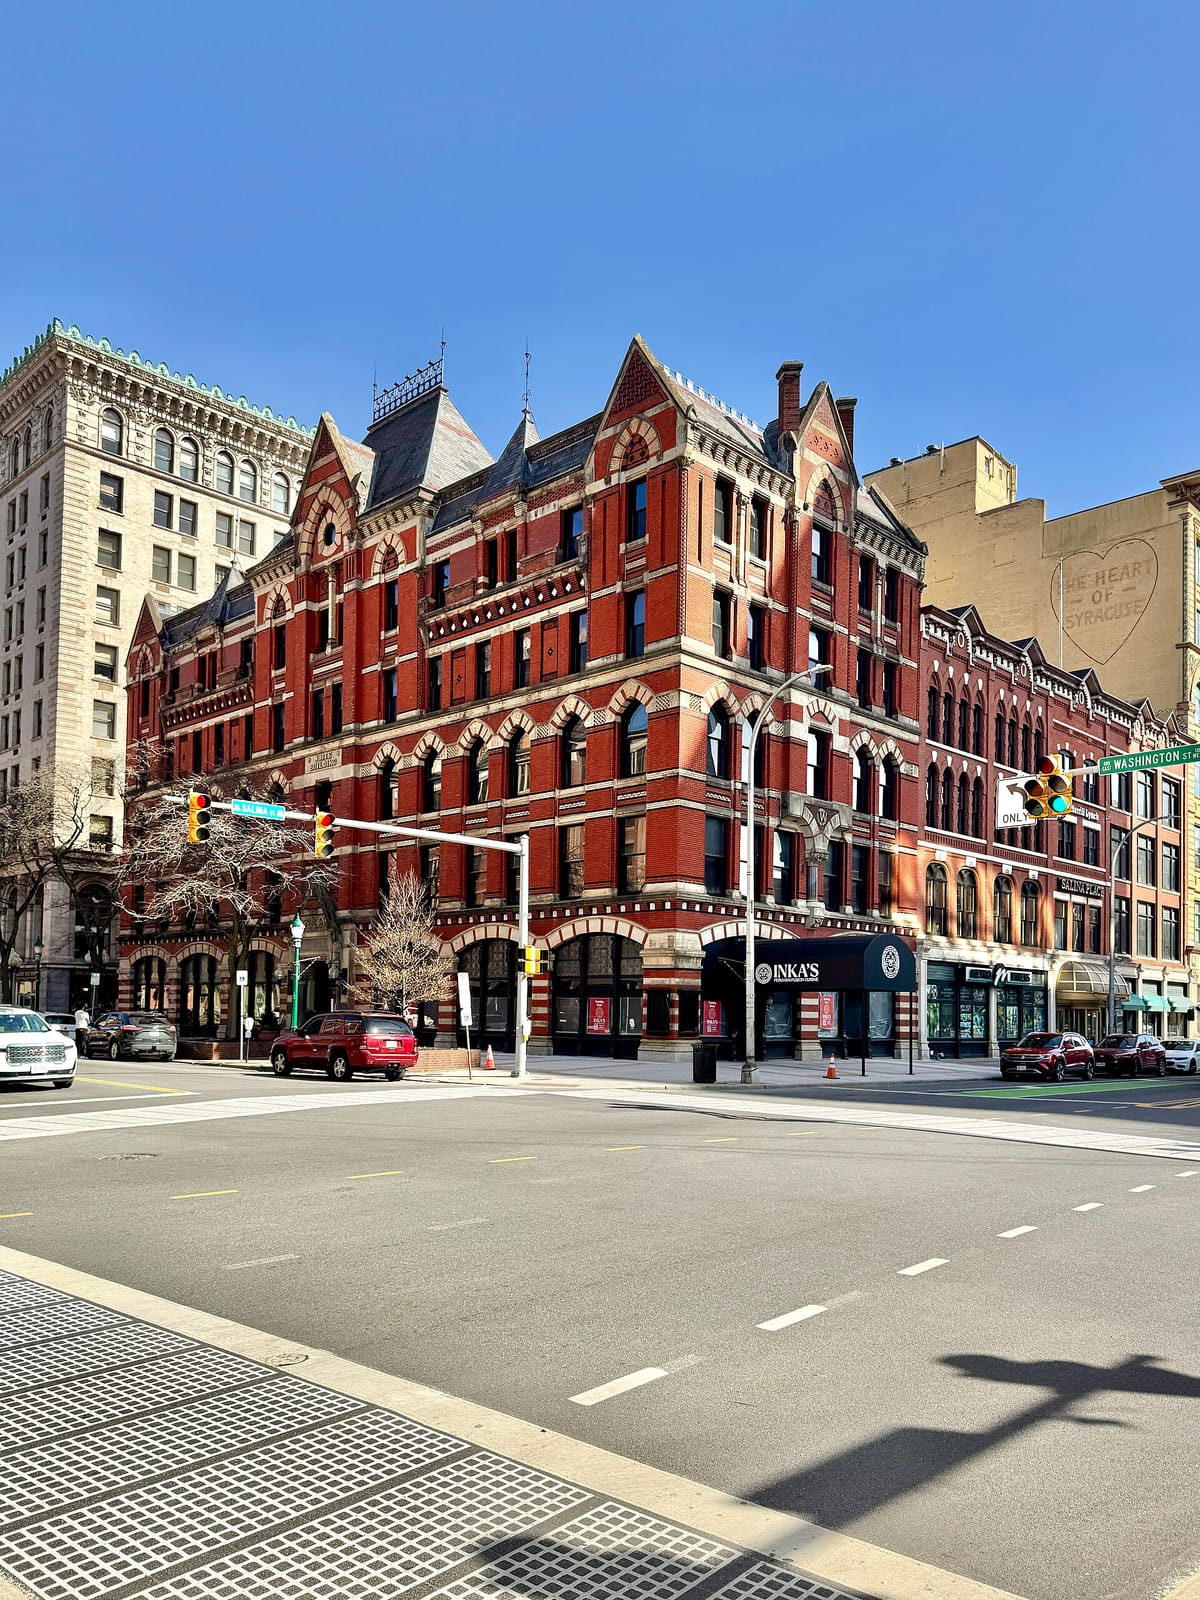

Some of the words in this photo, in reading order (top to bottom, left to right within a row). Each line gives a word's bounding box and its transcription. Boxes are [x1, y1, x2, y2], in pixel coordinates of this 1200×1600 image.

[1095, 560, 1152, 587] HEART
[1091, 587, 1114, 605] OF
[1065, 601, 1144, 629] SYRACUSE
[1113, 751, 1180, 770] WASHINGTON
[1182, 752, 1192, 760] ST
[241, 803, 269, 815] SALINA
[1003, 811, 1029, 824] ONLY
[1061, 878, 1085, 894] SALINA
[1086, 883, 1105, 897] PLACE
[773, 963, 820, 978] INKA'S
